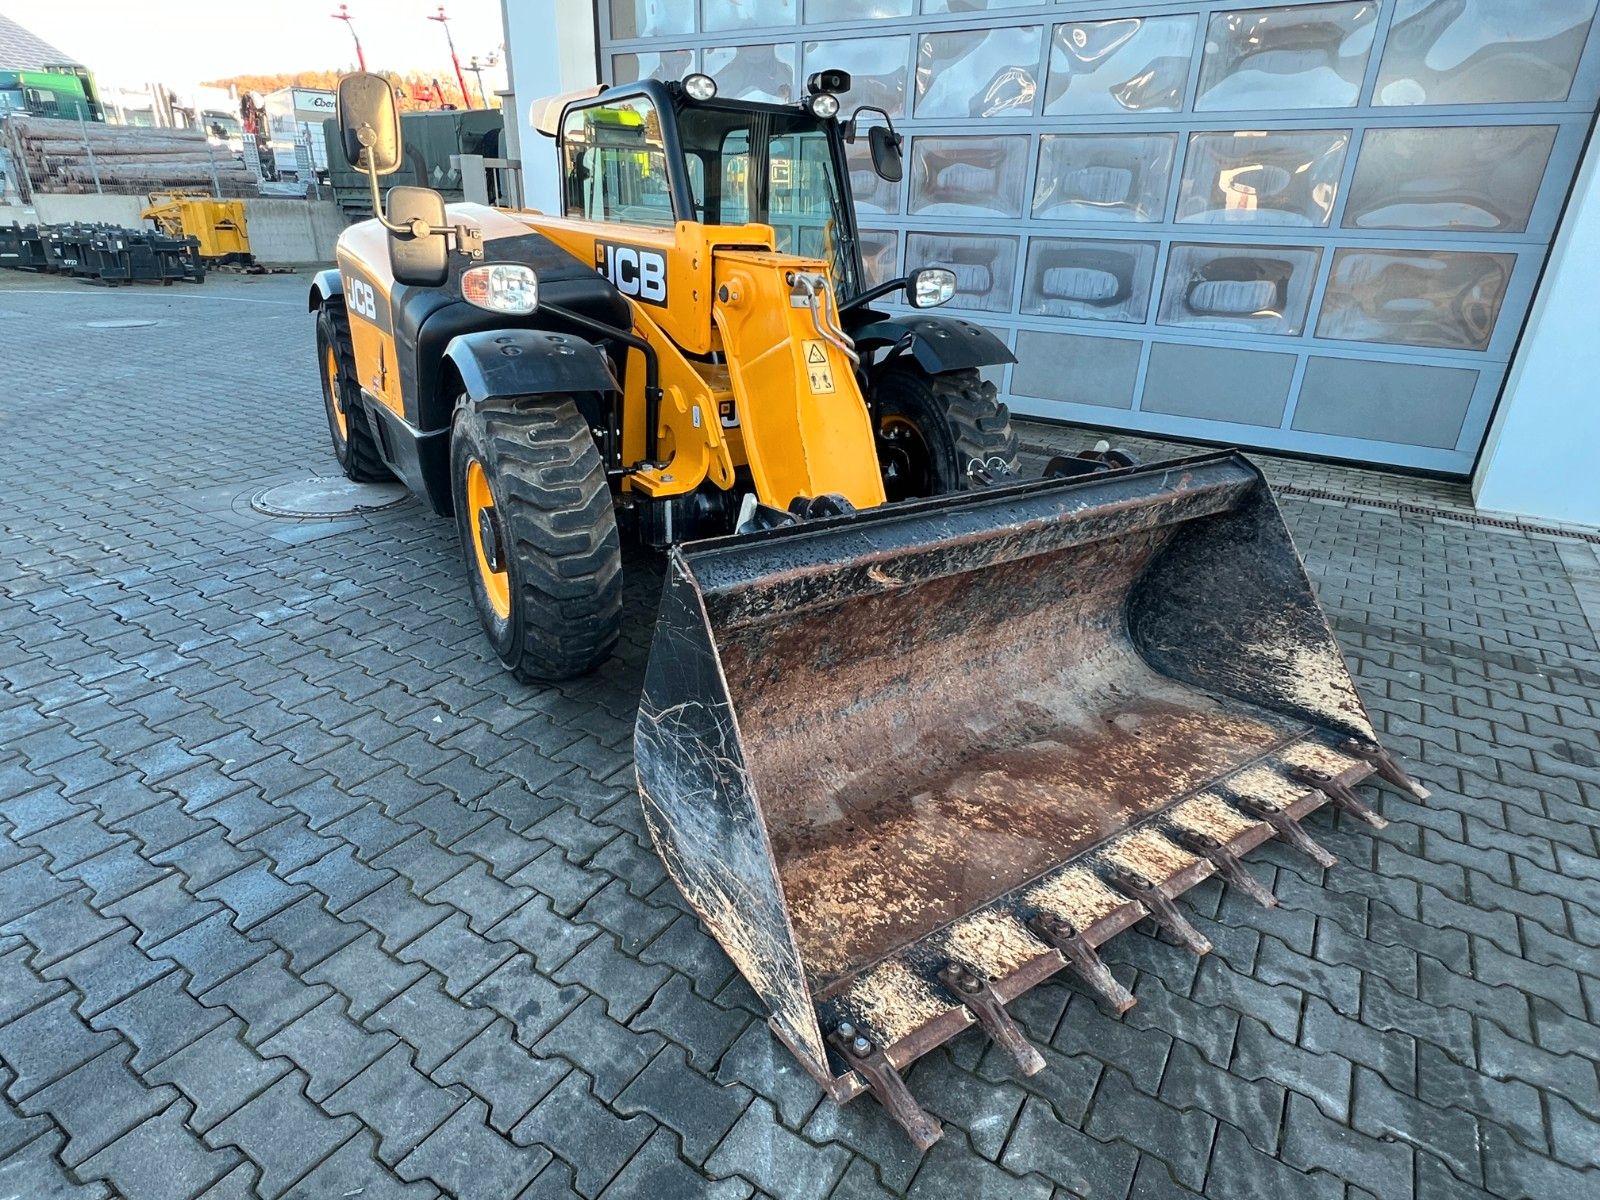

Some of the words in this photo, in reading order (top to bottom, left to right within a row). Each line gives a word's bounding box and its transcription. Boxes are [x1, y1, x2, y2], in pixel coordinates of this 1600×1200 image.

[314, 97, 336, 107] Eber
[597, 244, 666, 302] JCB
[347, 276, 377, 320] JCB
